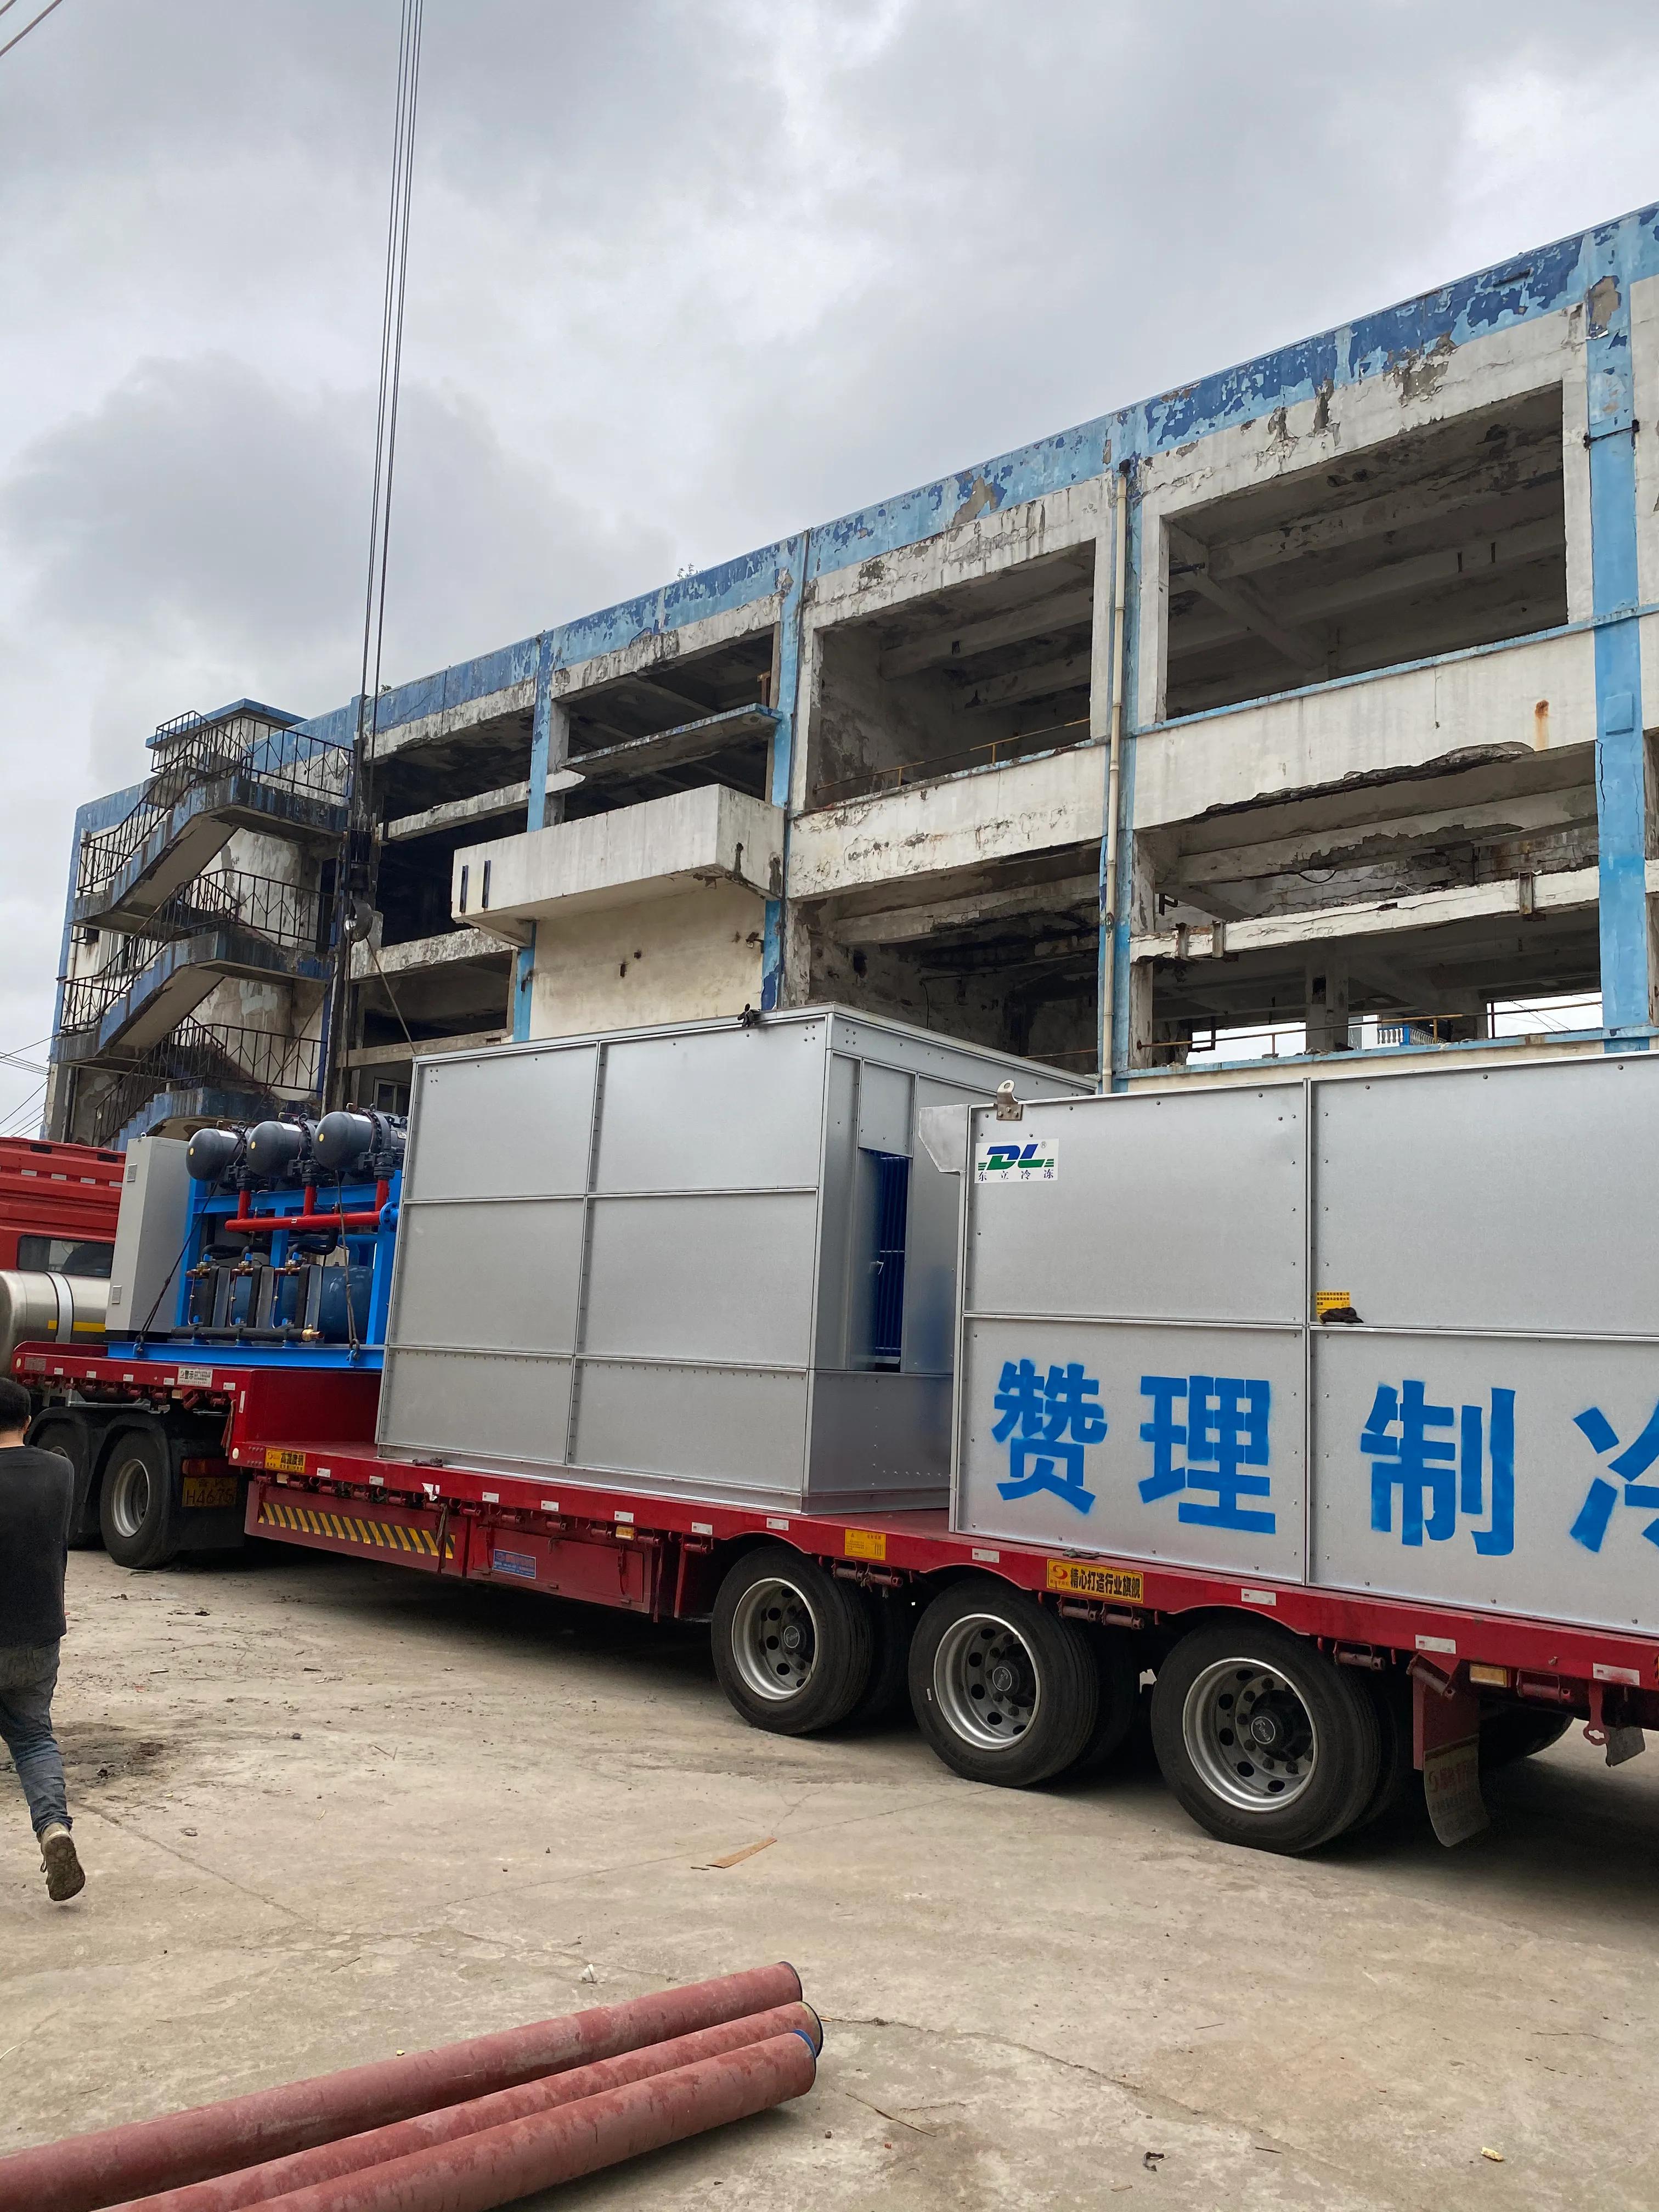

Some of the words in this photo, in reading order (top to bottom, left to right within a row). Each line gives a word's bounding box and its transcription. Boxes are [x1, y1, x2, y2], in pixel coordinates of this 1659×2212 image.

[986, 1144, 1045, 1170] DL
[978, 1169, 1054, 1182] 东立冷冻
[1070, 1567, 1141, 1599] 精心打造行业旗舰
